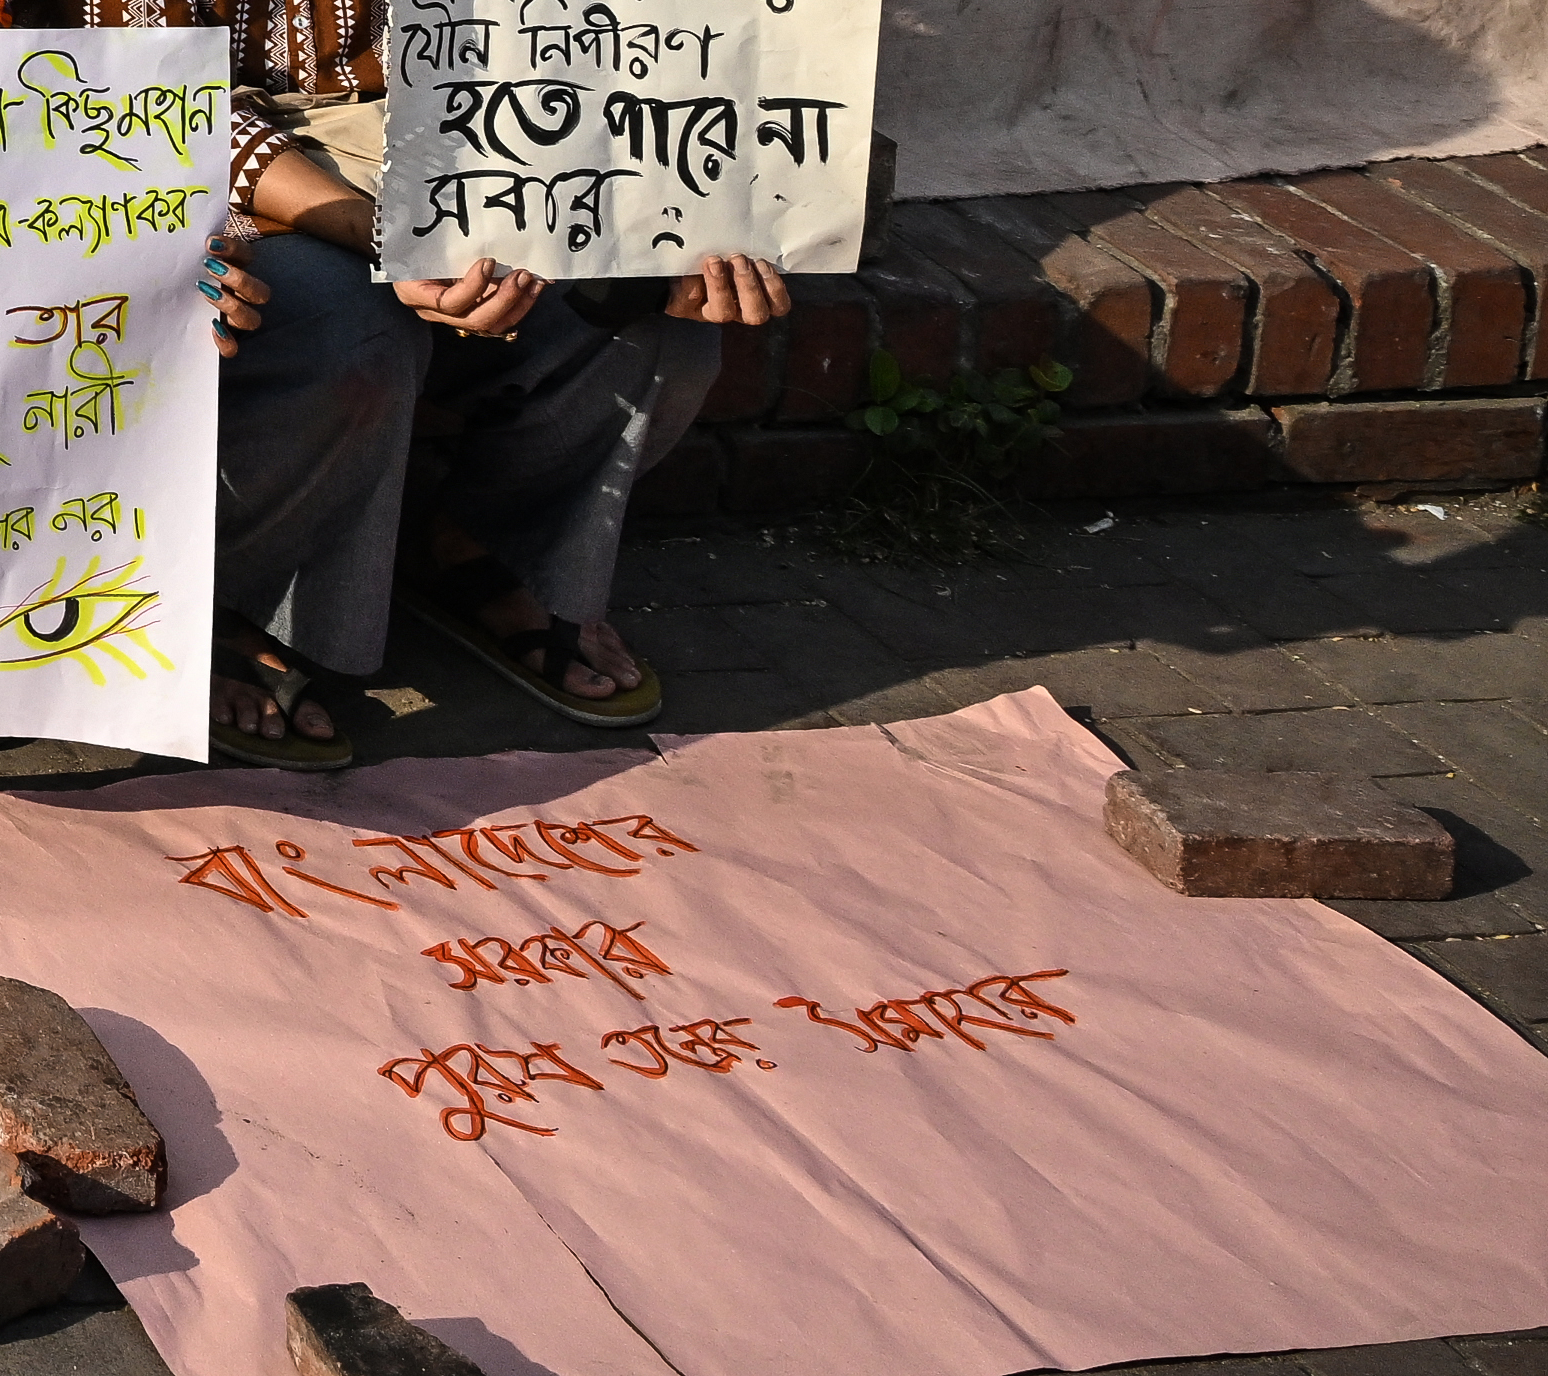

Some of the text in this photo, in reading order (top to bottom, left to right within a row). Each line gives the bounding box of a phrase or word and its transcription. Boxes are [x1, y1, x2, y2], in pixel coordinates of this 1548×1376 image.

[117, 84, 227, 156] মহান
[431, 79, 850, 198] হতে পারে না
[410, 168, 644, 253] সবার
[5, 295, 130, 347] তার
[23, 340, 135, 450] নারী
